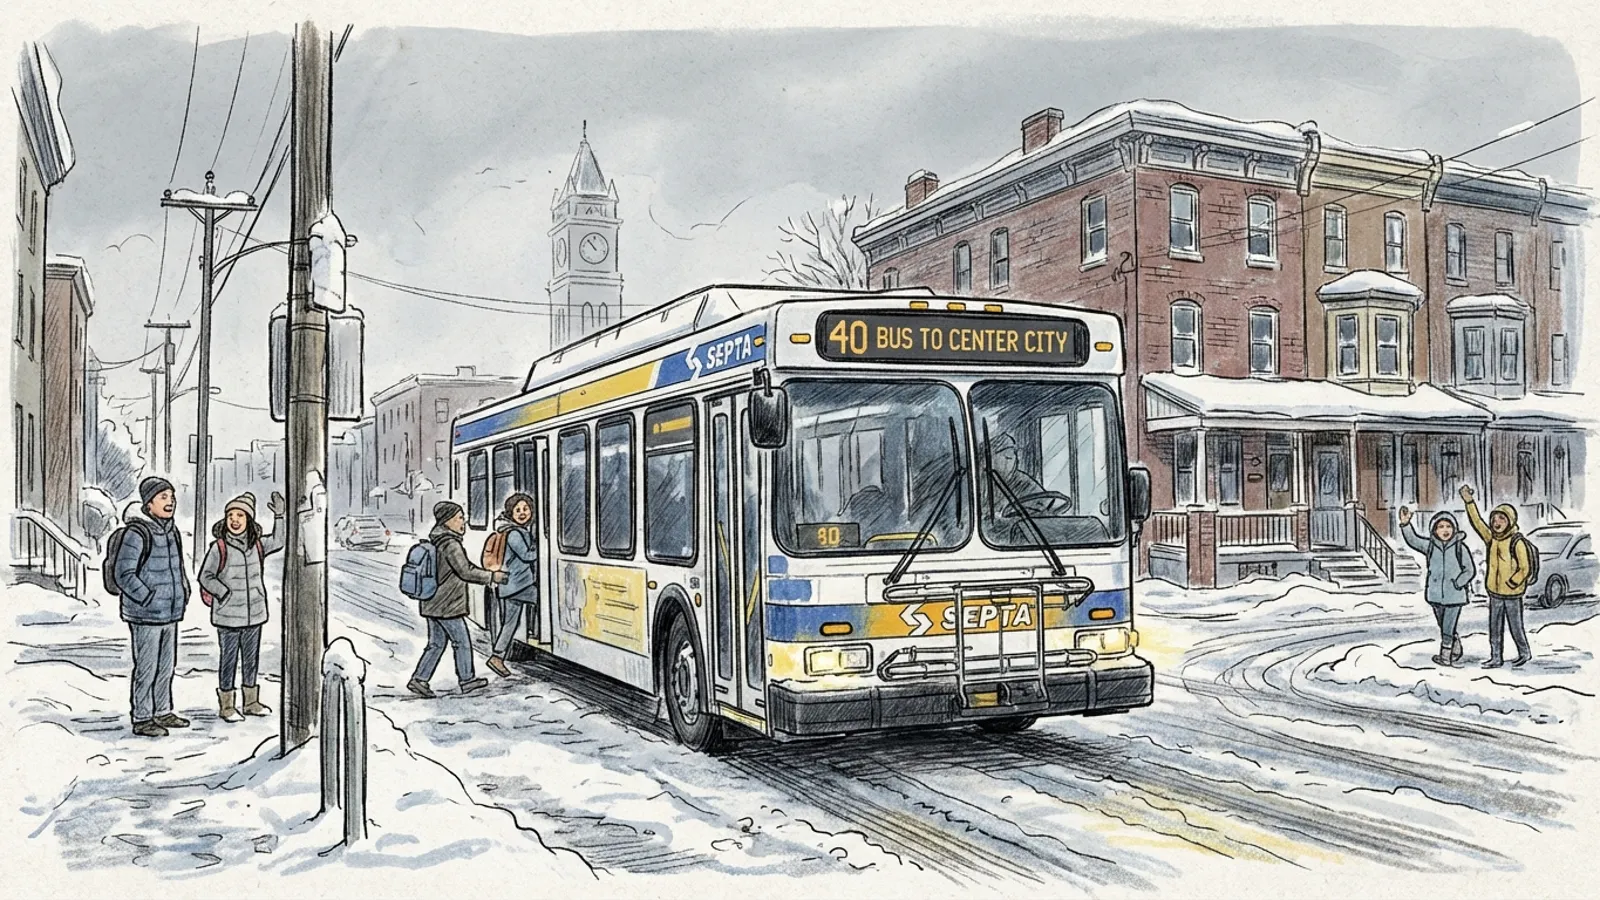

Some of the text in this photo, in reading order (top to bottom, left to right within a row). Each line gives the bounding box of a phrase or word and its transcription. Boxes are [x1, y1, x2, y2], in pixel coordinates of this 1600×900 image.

[706, 333, 752, 370] SEPTA
[829, 319, 1067, 355] 40 BUS TO CENTER CITY
[941, 602, 1033, 630] SEPTA
